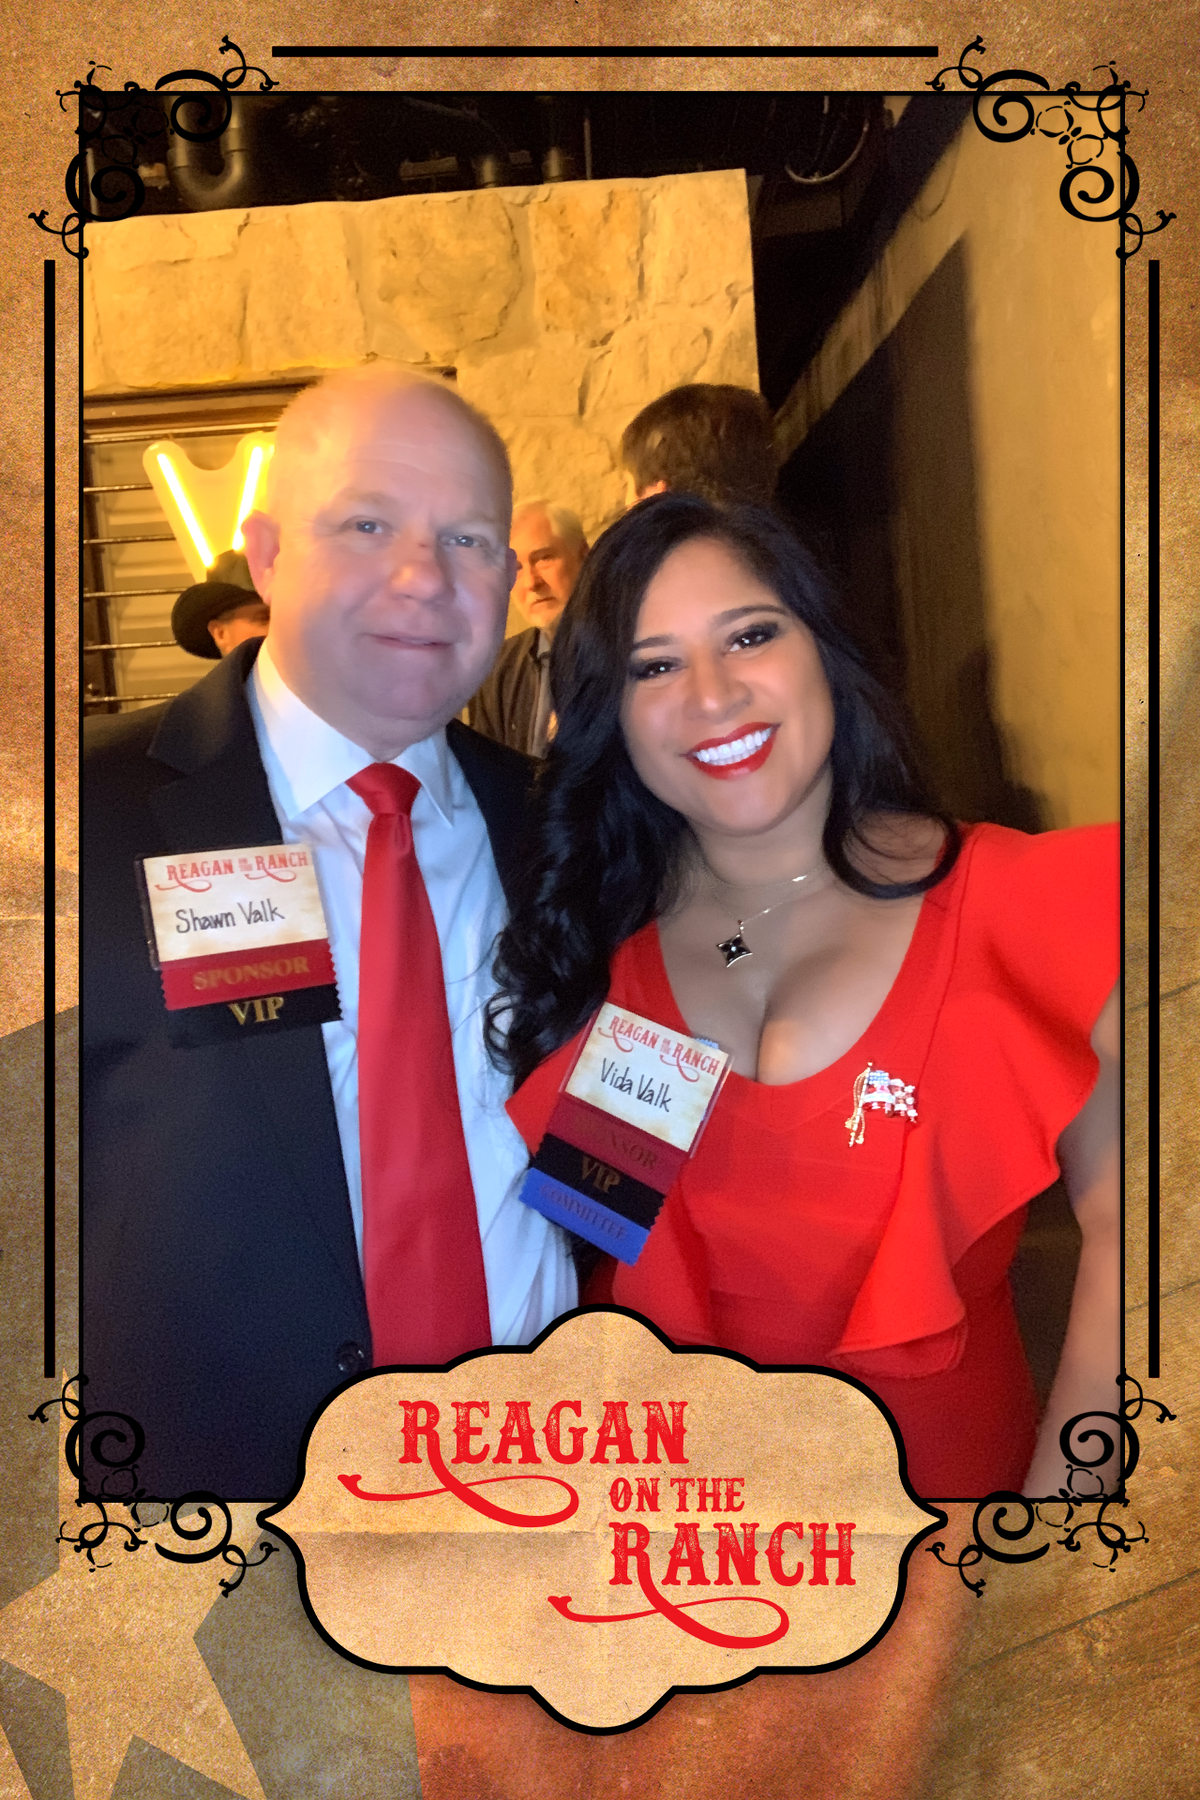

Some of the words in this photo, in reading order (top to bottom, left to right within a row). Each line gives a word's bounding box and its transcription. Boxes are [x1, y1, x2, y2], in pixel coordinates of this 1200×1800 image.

[175, 908, 236, 934] Shawn
[237, 898, 285, 925] Valk
[192, 956, 310, 990] SPONSOR
[228, 996, 285, 1026] VIP
[598, 1015, 661, 1053] REAGAN
[659, 1042, 721, 1083] RANCH
[600, 1057, 633, 1095] Vida
[637, 1074, 673, 1113] Valk
[581, 1155, 621, 1194] VIP
[540, 1183, 627, 1240] COMMITTEE
